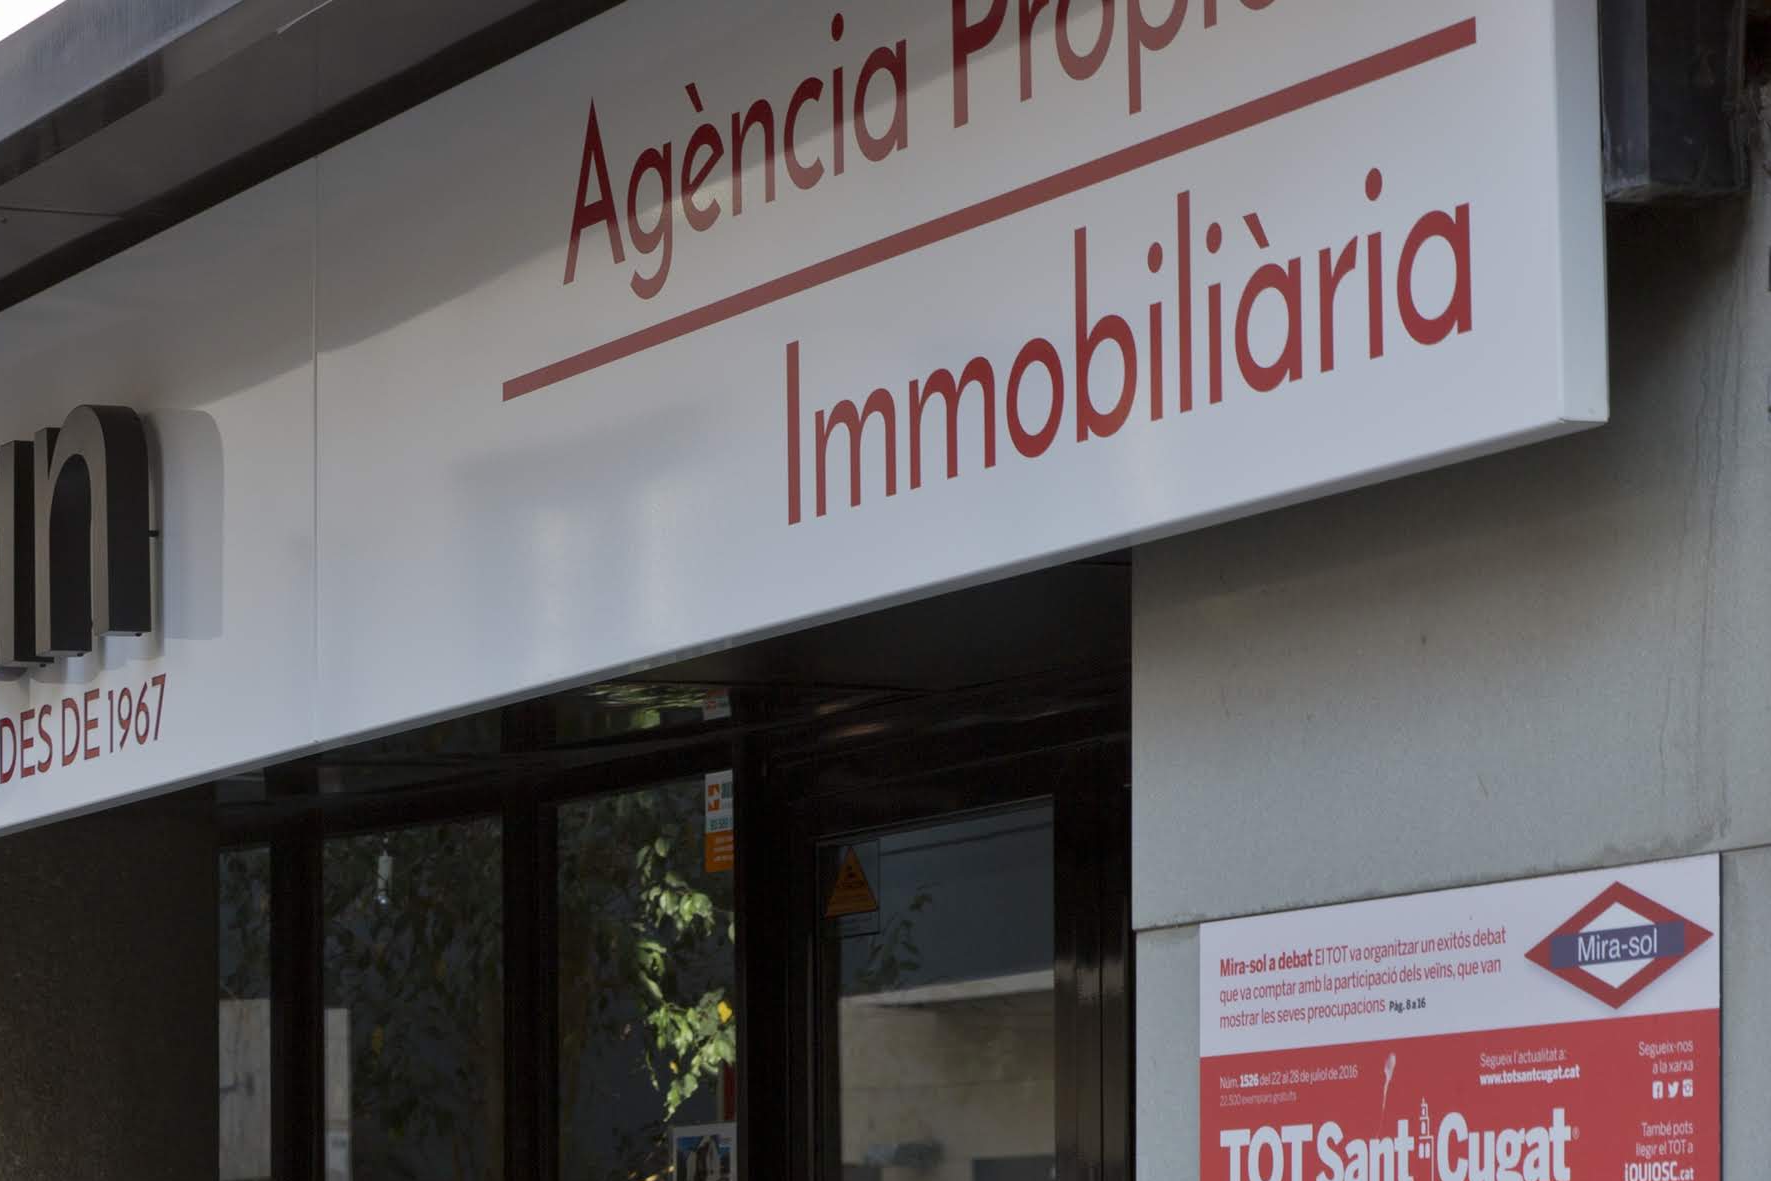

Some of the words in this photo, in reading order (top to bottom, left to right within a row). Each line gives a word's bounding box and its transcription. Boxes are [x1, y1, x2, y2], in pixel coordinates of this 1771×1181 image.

[562, 9, 909, 300] Agència
[952, 0, 1277, 128] Prop
[786, 167, 1473, 525] Immobiliària
[108, 673, 166, 754] 1967
[1220, 953, 1266, 977] Mira-sol
[1268, 957, 1276, 971] a
[1278, 947, 1313, 970] debat
[1315, 948, 1325, 966] El
[1326, 945, 1348, 965] TOT
[1349, 948, 1361, 961] va
[1363, 938, 1419, 963] organitzar
[1421, 939, 1435, 953] un
[1437, 930, 1471, 951] exitós
[1473, 926, 1506, 947] debat
[1577, 927, 1658, 963] Mira-sol
[1220, 988, 1239, 1006] que
[1240, 987, 1251, 1000] va
[1253, 981, 1296, 1000] comptar
[1298, 976, 1321, 995] amb
[1323, 973, 1332, 991] la
[1333, 966, 1397, 996] participació
[1399, 962, 1422, 984] dels
[1423, 962, 1456, 981] veïns,
[1457, 961, 1478, 980] que
[1480, 958, 1501, 974] van
[1220, 1011, 1260, 1030] mostrar
[1261, 1008, 1275, 1024] les
[1277, 1007, 1306, 1022] seves
[1308, 996, 1385, 1023] preocupacions
[1417, 997, 1426, 1009] 16
[1638, 1040, 1693, 1058] Segueix-nos
[1240, 1074, 1259, 1088] 1526
[1339, 1064, 1358, 1080] 2016
[1479, 1065, 1580, 1085] www.totsantcugat.cat
[1653, 1064, 1658, 1075] a
[1659, 1060, 1668, 1074] la
[1668, 1060, 1693, 1072] xarxa
[1641, 1122, 1671, 1137] També
[1672, 1121, 1693, 1139] pots
[1636, 1142, 1658, 1160] llegir
[1659, 1141, 1667, 1156] el
[1668, 1139, 1687, 1155] TOT
[1688, 1142, 1694, 1154] a
